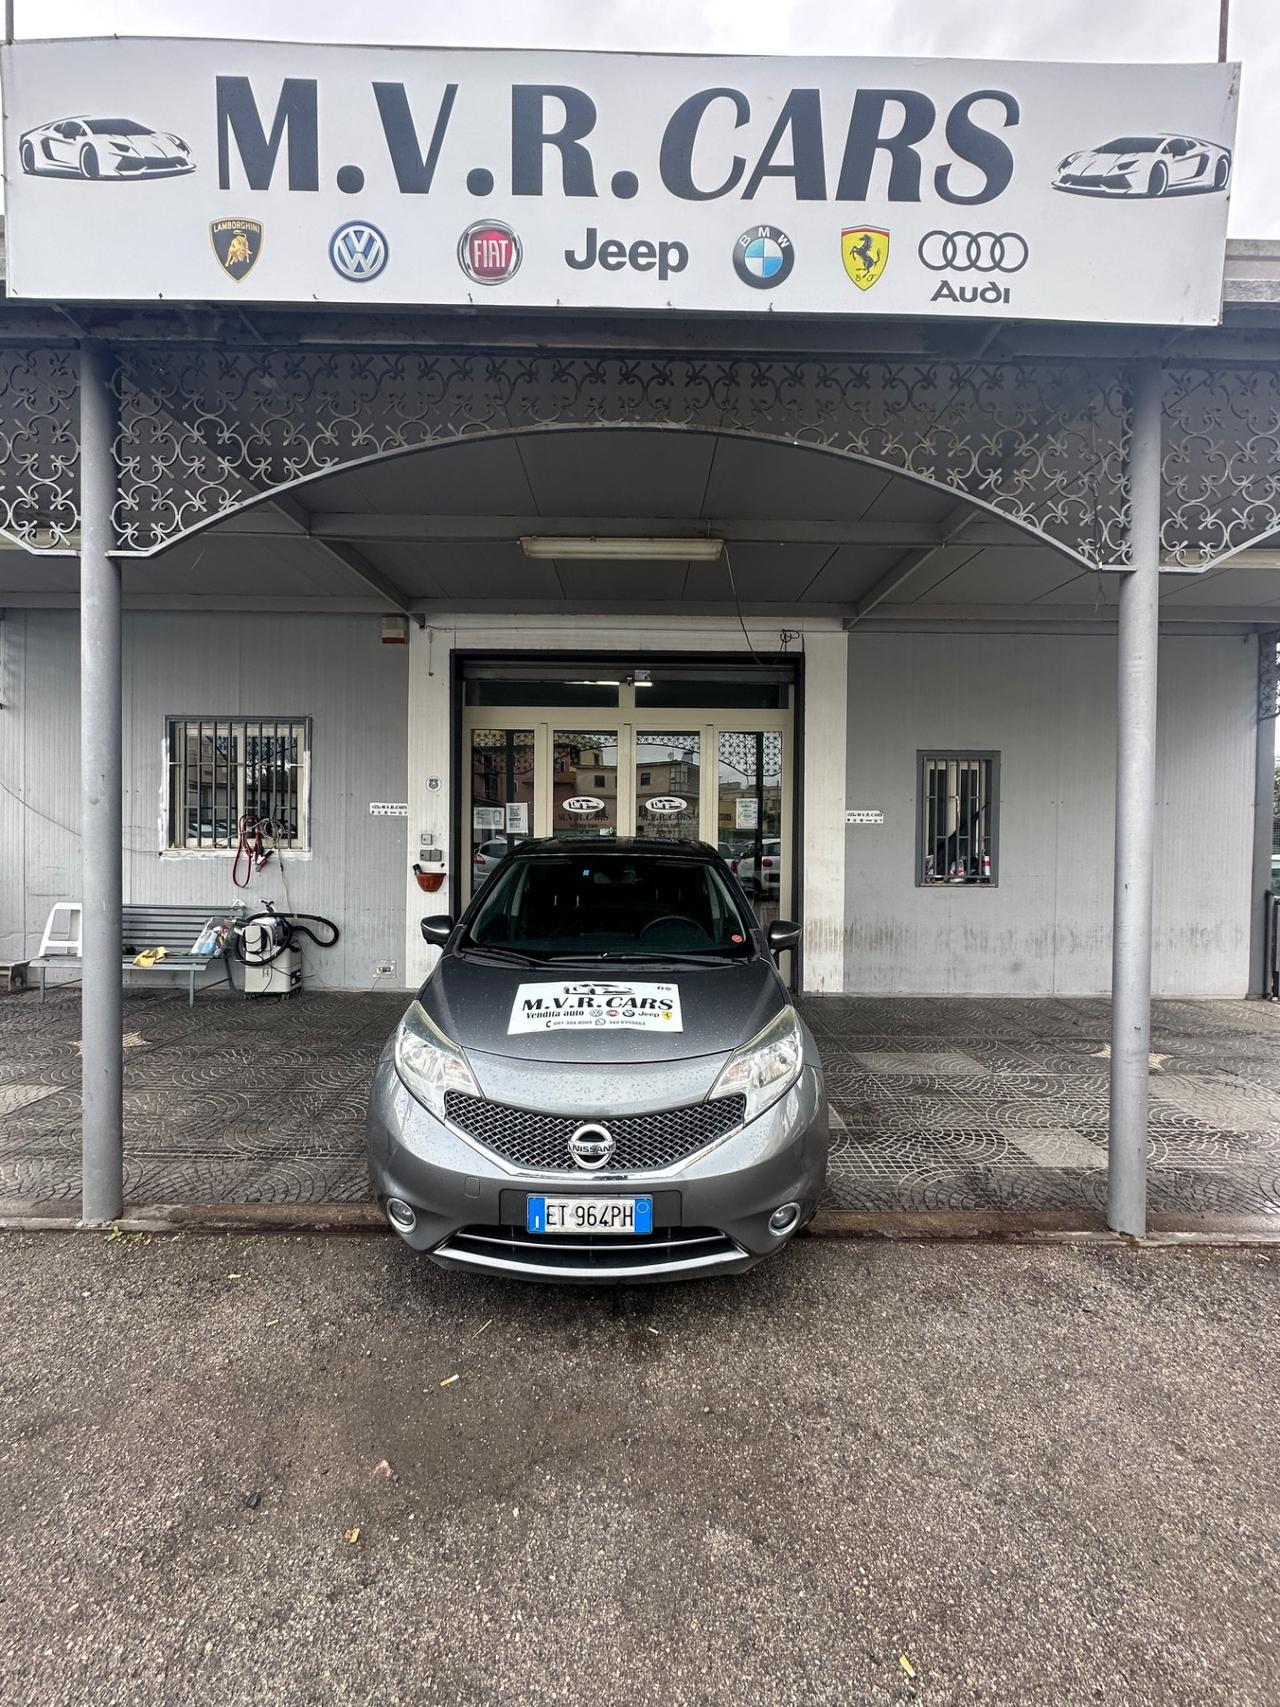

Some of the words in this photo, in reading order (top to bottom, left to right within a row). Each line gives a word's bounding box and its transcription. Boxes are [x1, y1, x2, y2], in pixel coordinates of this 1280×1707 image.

[213, 221, 261, 233] LAMBORGHINI
[473, 239, 509, 268] FIAT
[564, 227, 689, 280] Jeep
[930, 280, 1011, 304] Audi
[526, 1010, 561, 1020] Vendita
[563, 1009, 584, 1017] auto
[572, 1144, 611, 1152] NISSAN
[546, 1205, 566, 1226] ET
[575, 1205, 634, 1227] 964PH
